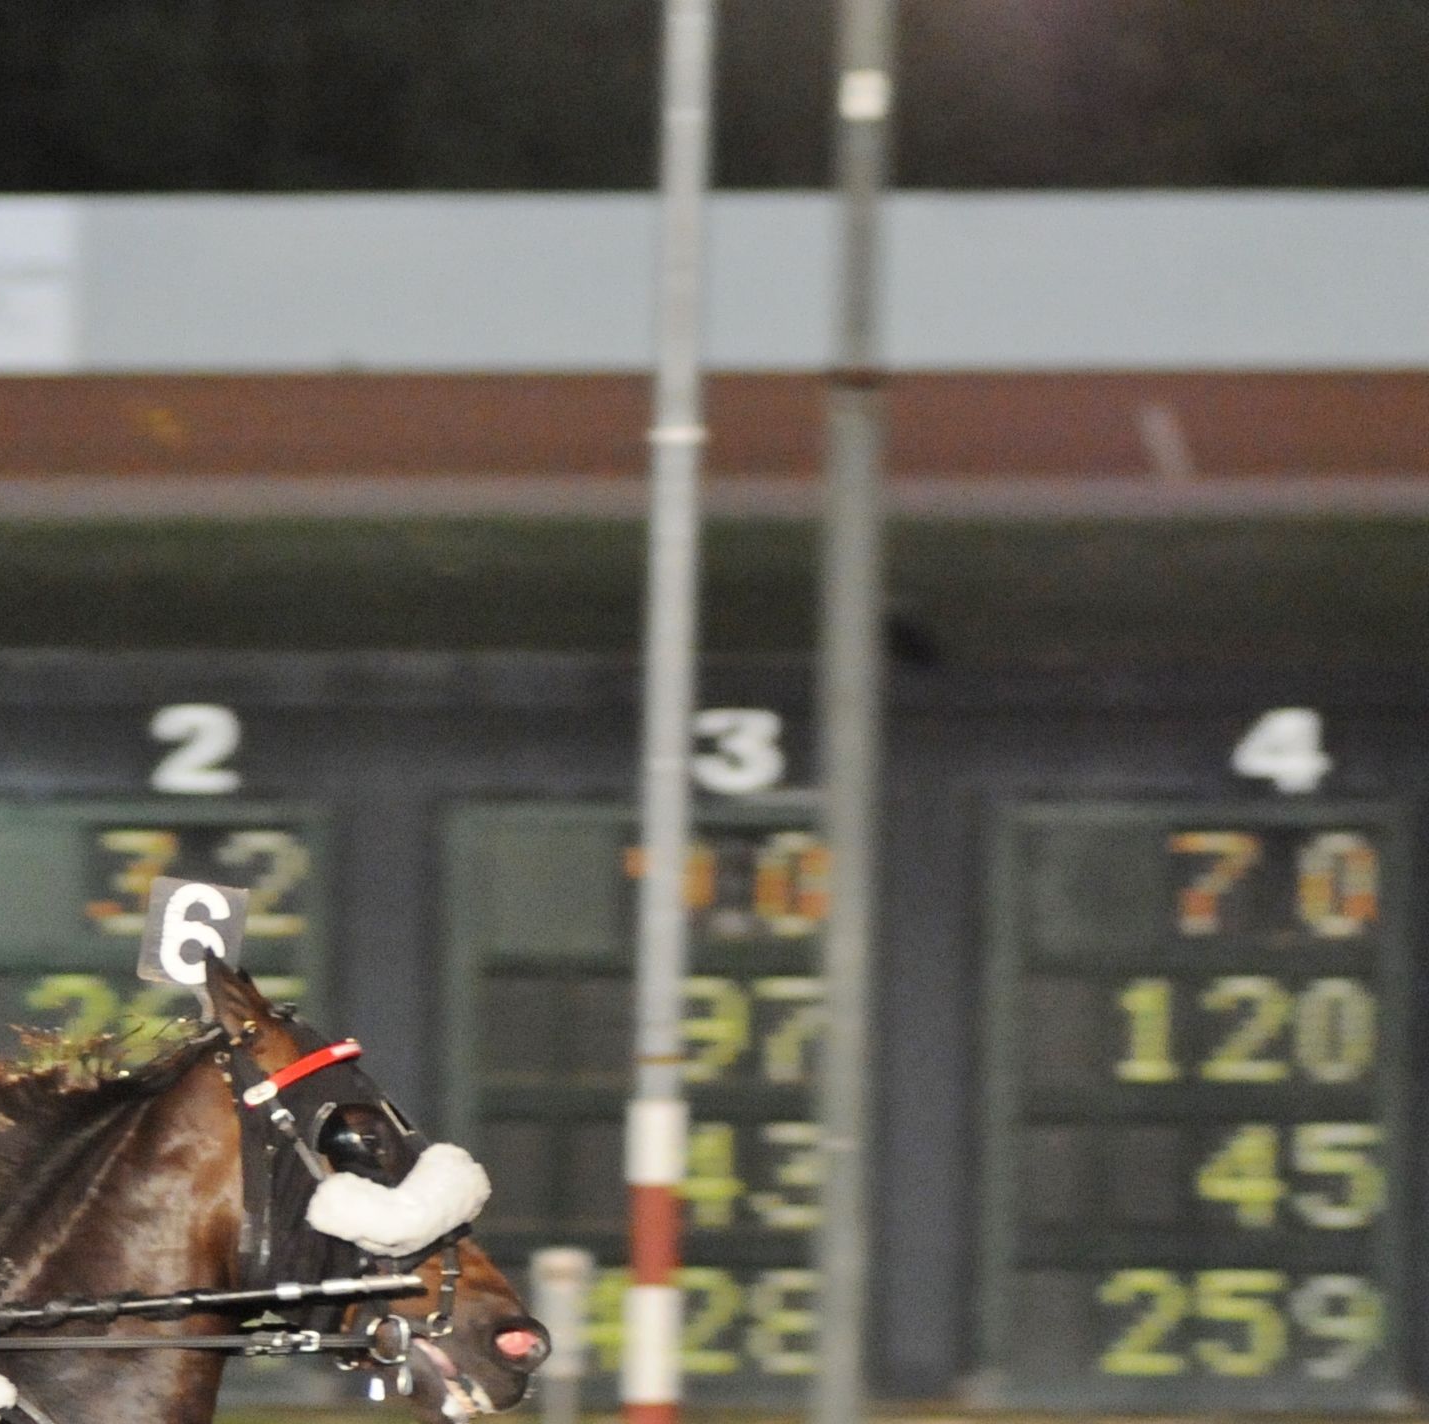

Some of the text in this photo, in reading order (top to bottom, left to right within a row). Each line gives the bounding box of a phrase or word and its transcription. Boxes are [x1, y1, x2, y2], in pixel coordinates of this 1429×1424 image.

[149, 702, 242, 794] 2
[692, 707, 786, 794] 3
[1233, 706, 1332, 794] 4
[159, 882, 231, 985] 6
[1114, 973, 1381, 1084] 120
[1196, 1122, 1391, 1230] 45
[1097, 1267, 1391, 1380] 259
